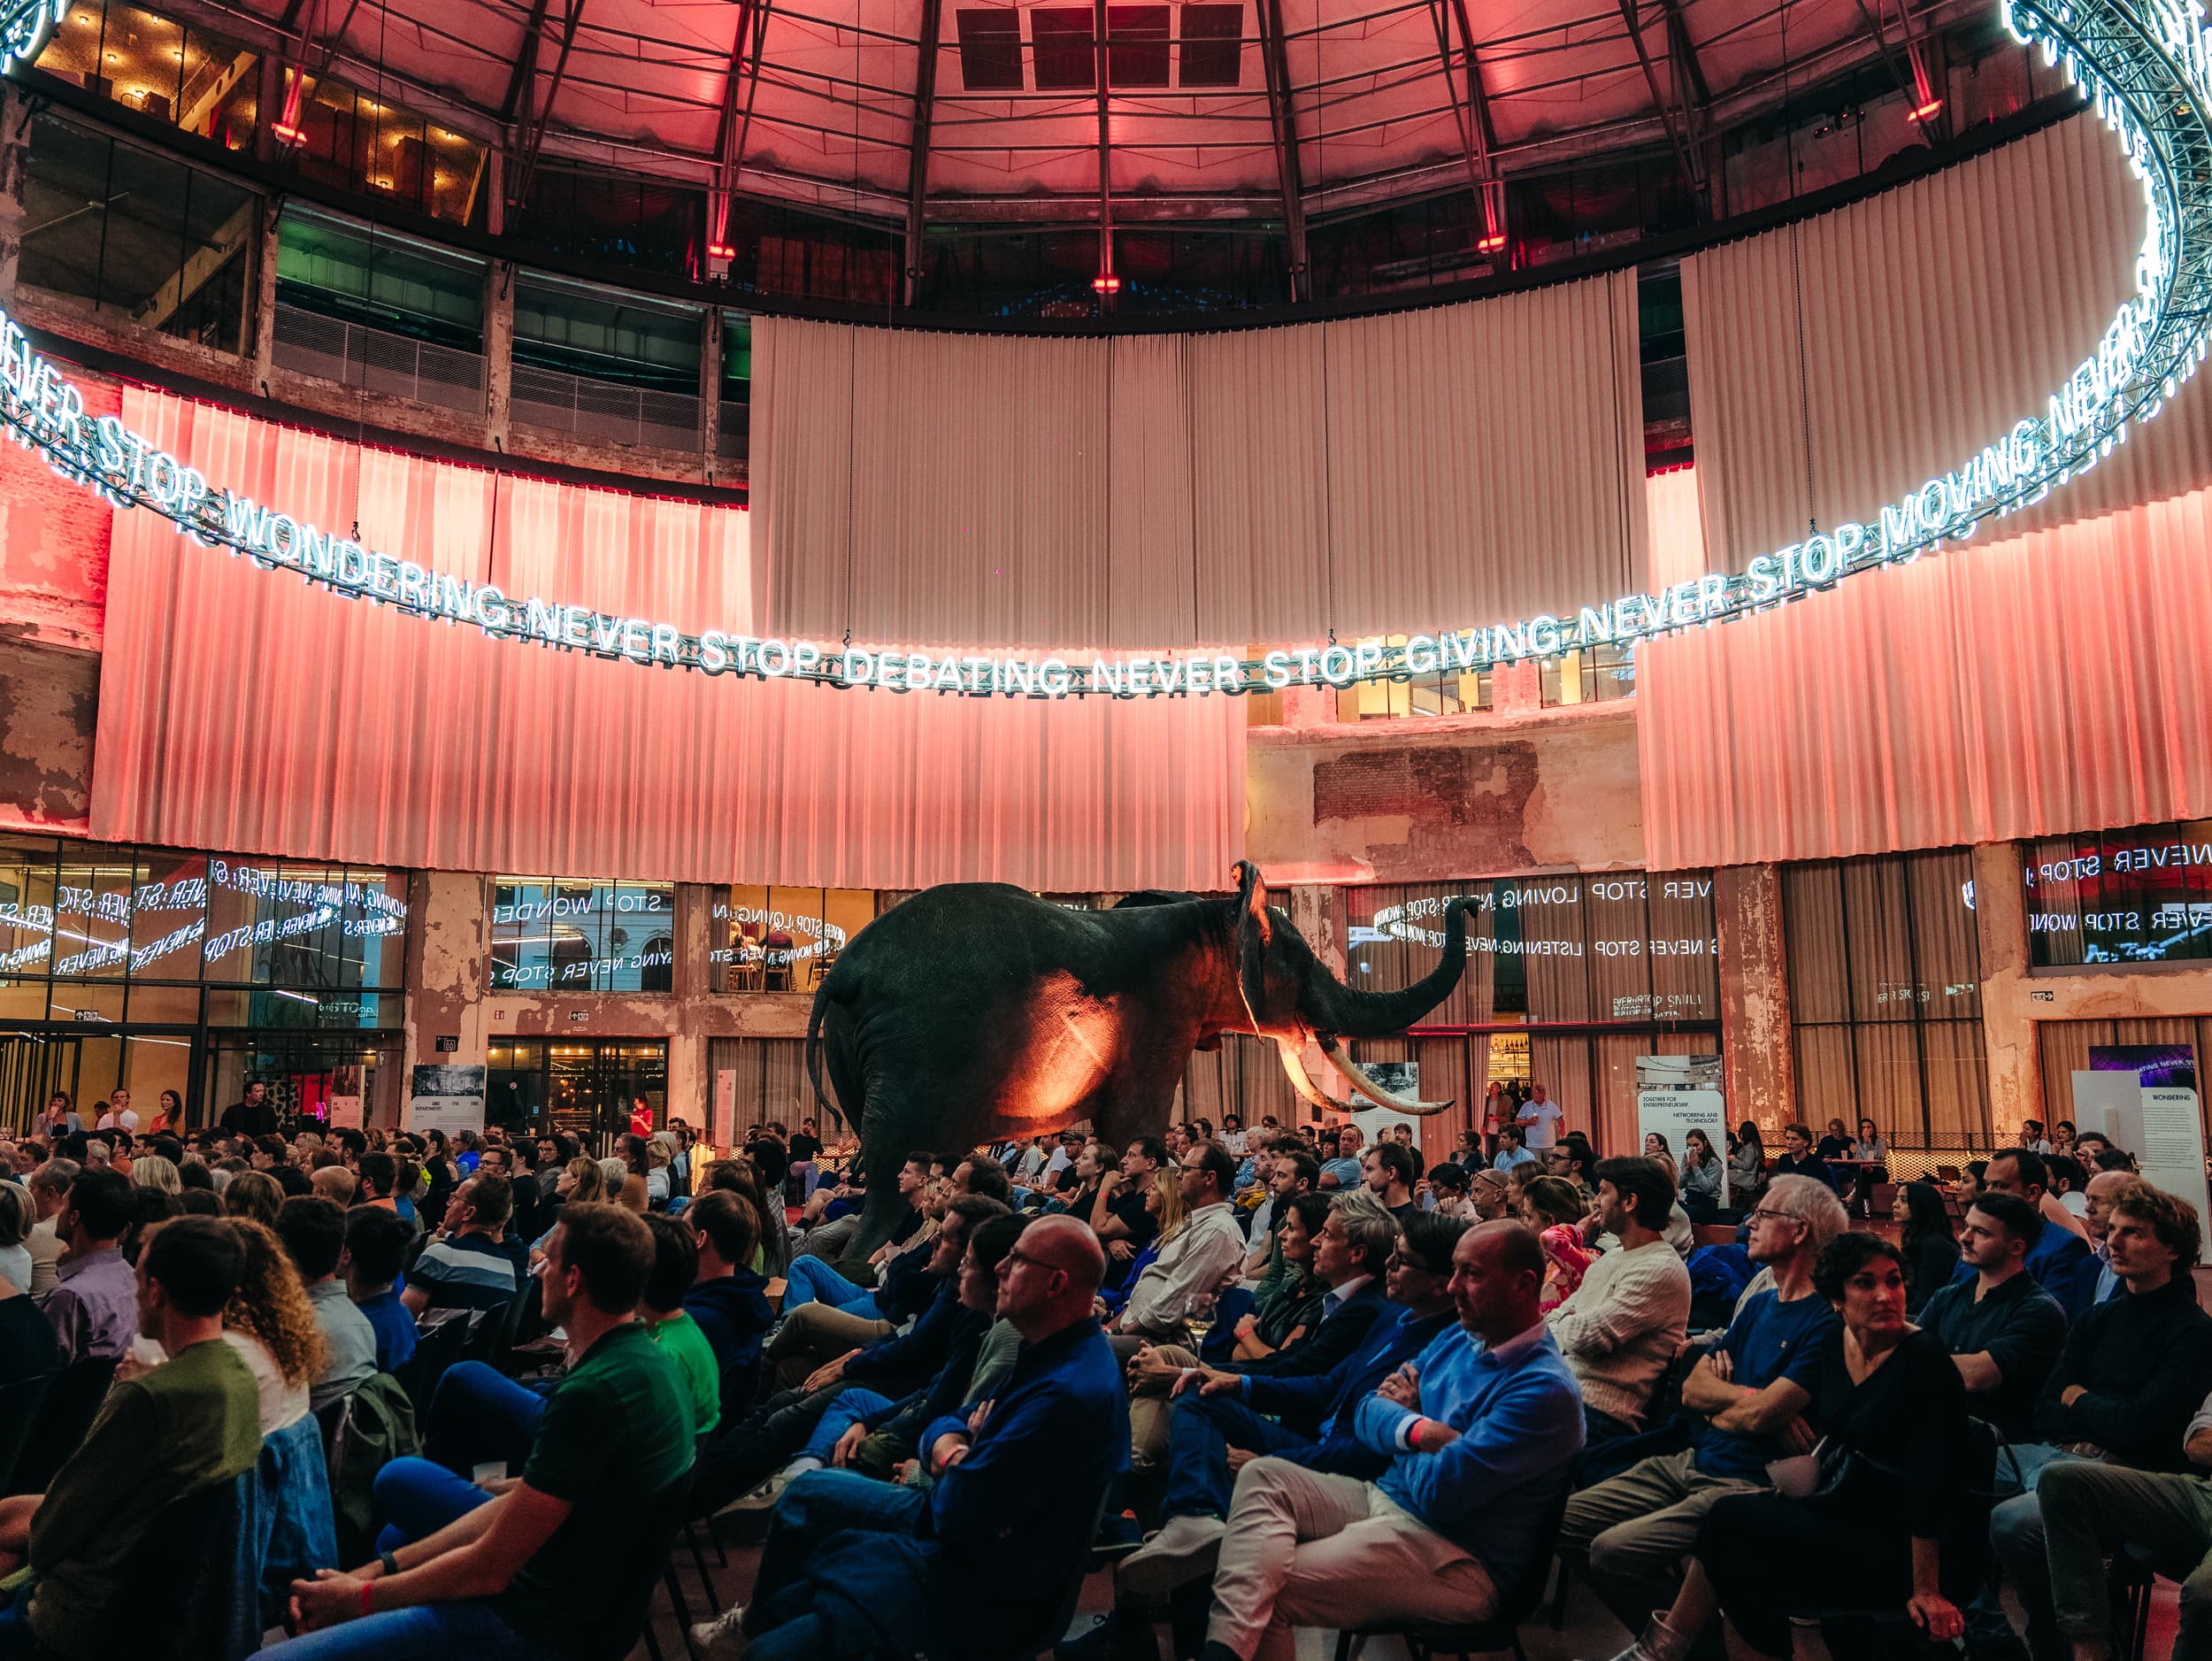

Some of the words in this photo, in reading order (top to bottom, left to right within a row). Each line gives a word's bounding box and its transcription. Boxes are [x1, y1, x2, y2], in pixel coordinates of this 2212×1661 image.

[97, 415, 207, 513] STOP
[224, 487, 509, 629] WONDERING
[527, 596, 680, 665] NEVER
[698, 630, 821, 678] STOP
[842, 647, 1069, 695] DEBATING
[1091, 656, 1240, 694] NEVER
[1263, 644, 1384, 688] STOP
[1405, 613, 1563, 675] GIVING
[1578, 572, 1730, 643] NEVER
[1747, 522, 1867, 603] STOP
[1879, 416, 2040, 556] MOVING
[2048, 302, 2147, 450] NEVER
